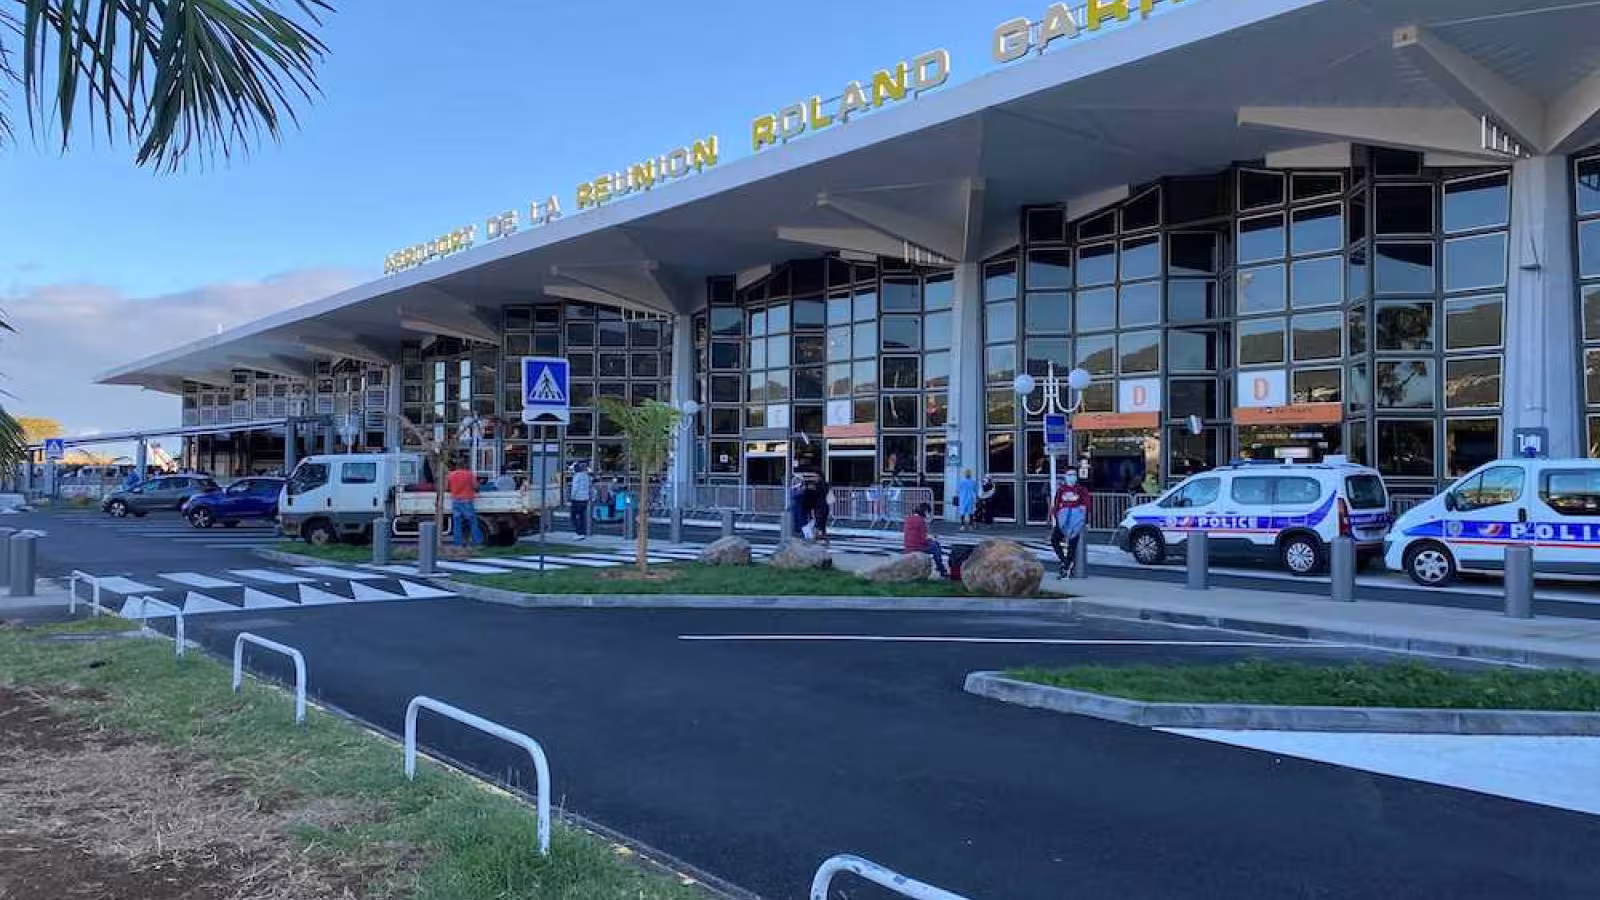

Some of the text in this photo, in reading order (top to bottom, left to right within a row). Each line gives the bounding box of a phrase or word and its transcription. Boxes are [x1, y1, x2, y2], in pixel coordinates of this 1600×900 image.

[486, 209, 519, 241] DE
[530, 194, 562, 226] LA
[752, 48, 950, 152] ROLAND
[1197, 516, 1258, 529] POLICE
[1510, 523, 1600, 542] POLI
